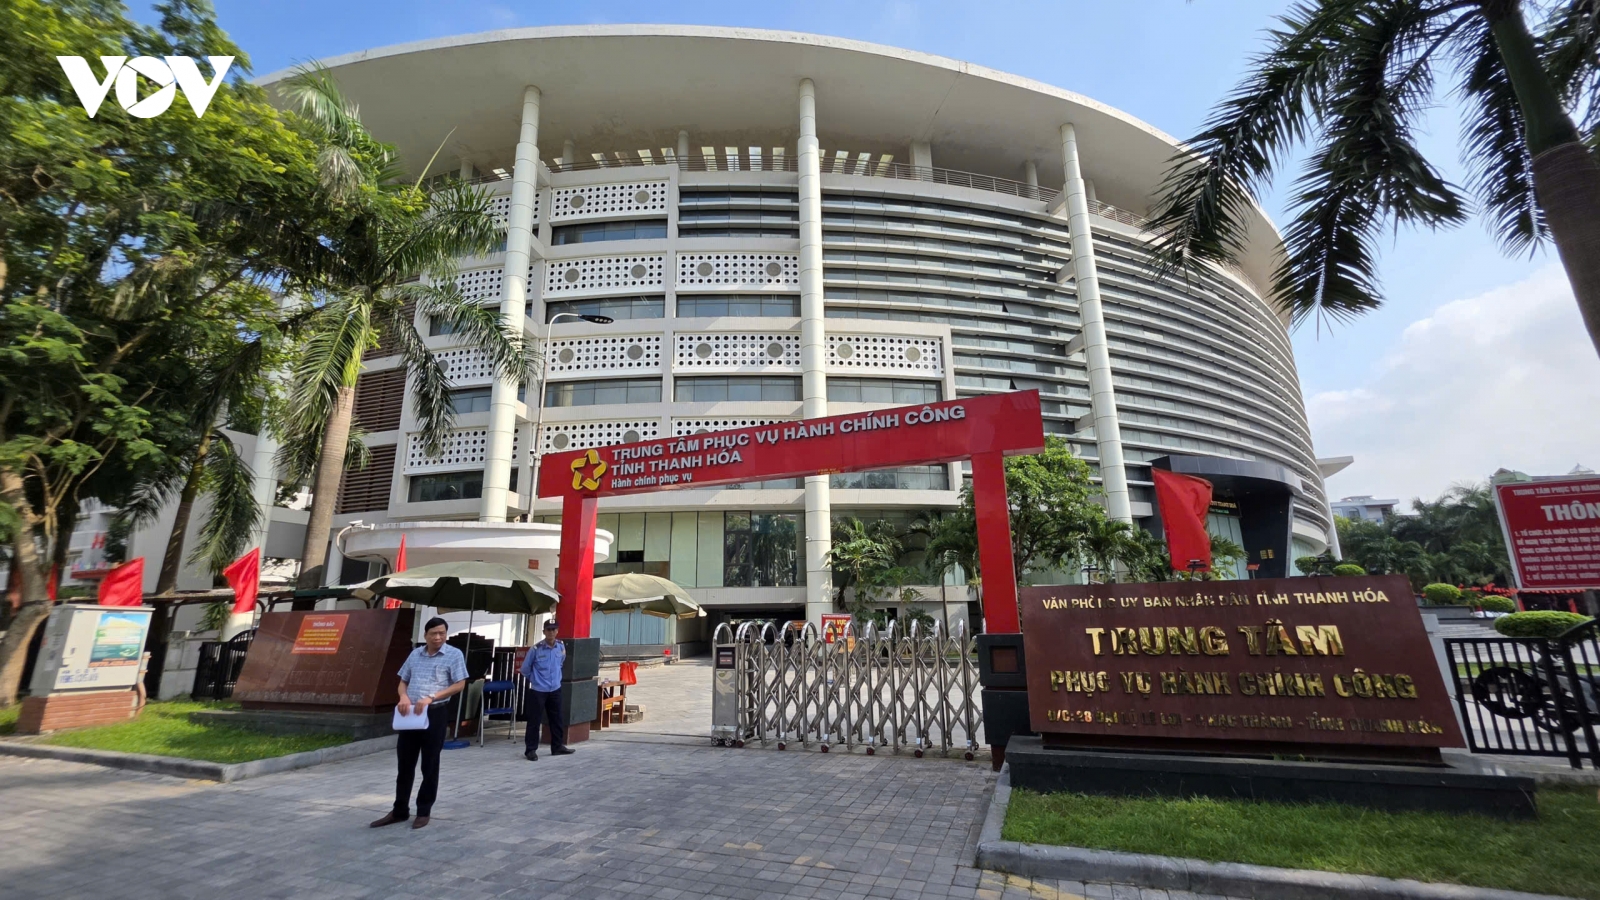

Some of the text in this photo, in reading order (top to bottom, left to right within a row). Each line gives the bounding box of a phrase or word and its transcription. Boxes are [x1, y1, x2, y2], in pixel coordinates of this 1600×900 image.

[612, 405, 966, 461] TRUNG TÂM PHỤC VỤ HÀNH CHÍNH CÔNG
[611, 449, 743, 476] TỈNH THANH HÓA
[611, 473, 692, 489] Hành chính phục vụ
[1042, 596, 1067, 609] VĂN
[1144, 596, 1172, 608] BAN
[1175, 592, 1215, 608] NHÂN
[1293, 591, 1349, 604] THANH
[1352, 587, 1390, 604] HÓA
[1085, 618, 1346, 656] TRUNG TÂM
[1050, 666, 1418, 699] PHỤC VỤ HÀNH CHÍNH CÔNG
